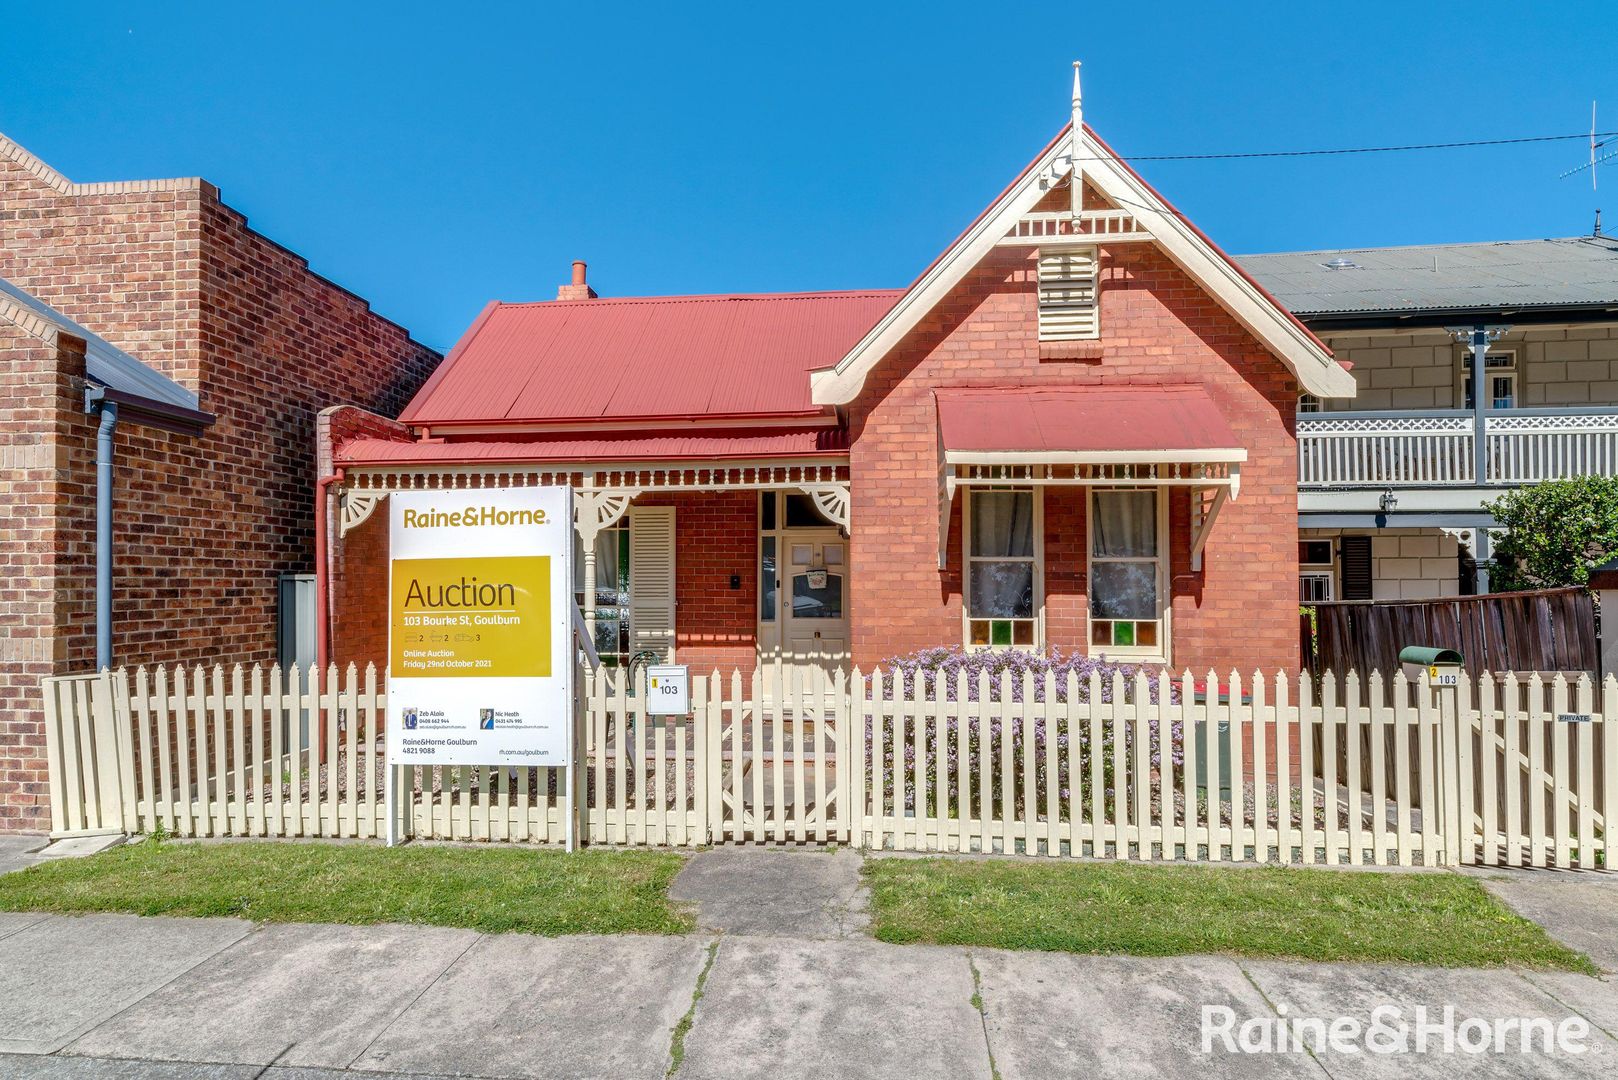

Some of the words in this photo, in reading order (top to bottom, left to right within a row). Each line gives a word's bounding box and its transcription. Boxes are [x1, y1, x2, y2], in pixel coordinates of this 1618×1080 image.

[403, 506, 546, 529] Raine&Horne
[404, 576, 515, 607] Auction
[404, 616, 421, 626] 103
[423, 615, 457, 626] Bourke
[460, 615, 472, 627] St,
[474, 615, 520, 625] Goulburn
[403, 650, 426, 658] Online
[427, 649, 454, 657] Auction
[403, 660, 425, 669] Friday
[426, 660, 445, 668] 29nd
[475, 659, 492, 667] 2021
[1431, 668, 1437, 677] 2
[1439, 675, 1457, 684] 103
[660, 686, 678, 694] 103
[402, 738, 446, 746] Raine&Horne
[446, 738, 478, 746] Goulburn
